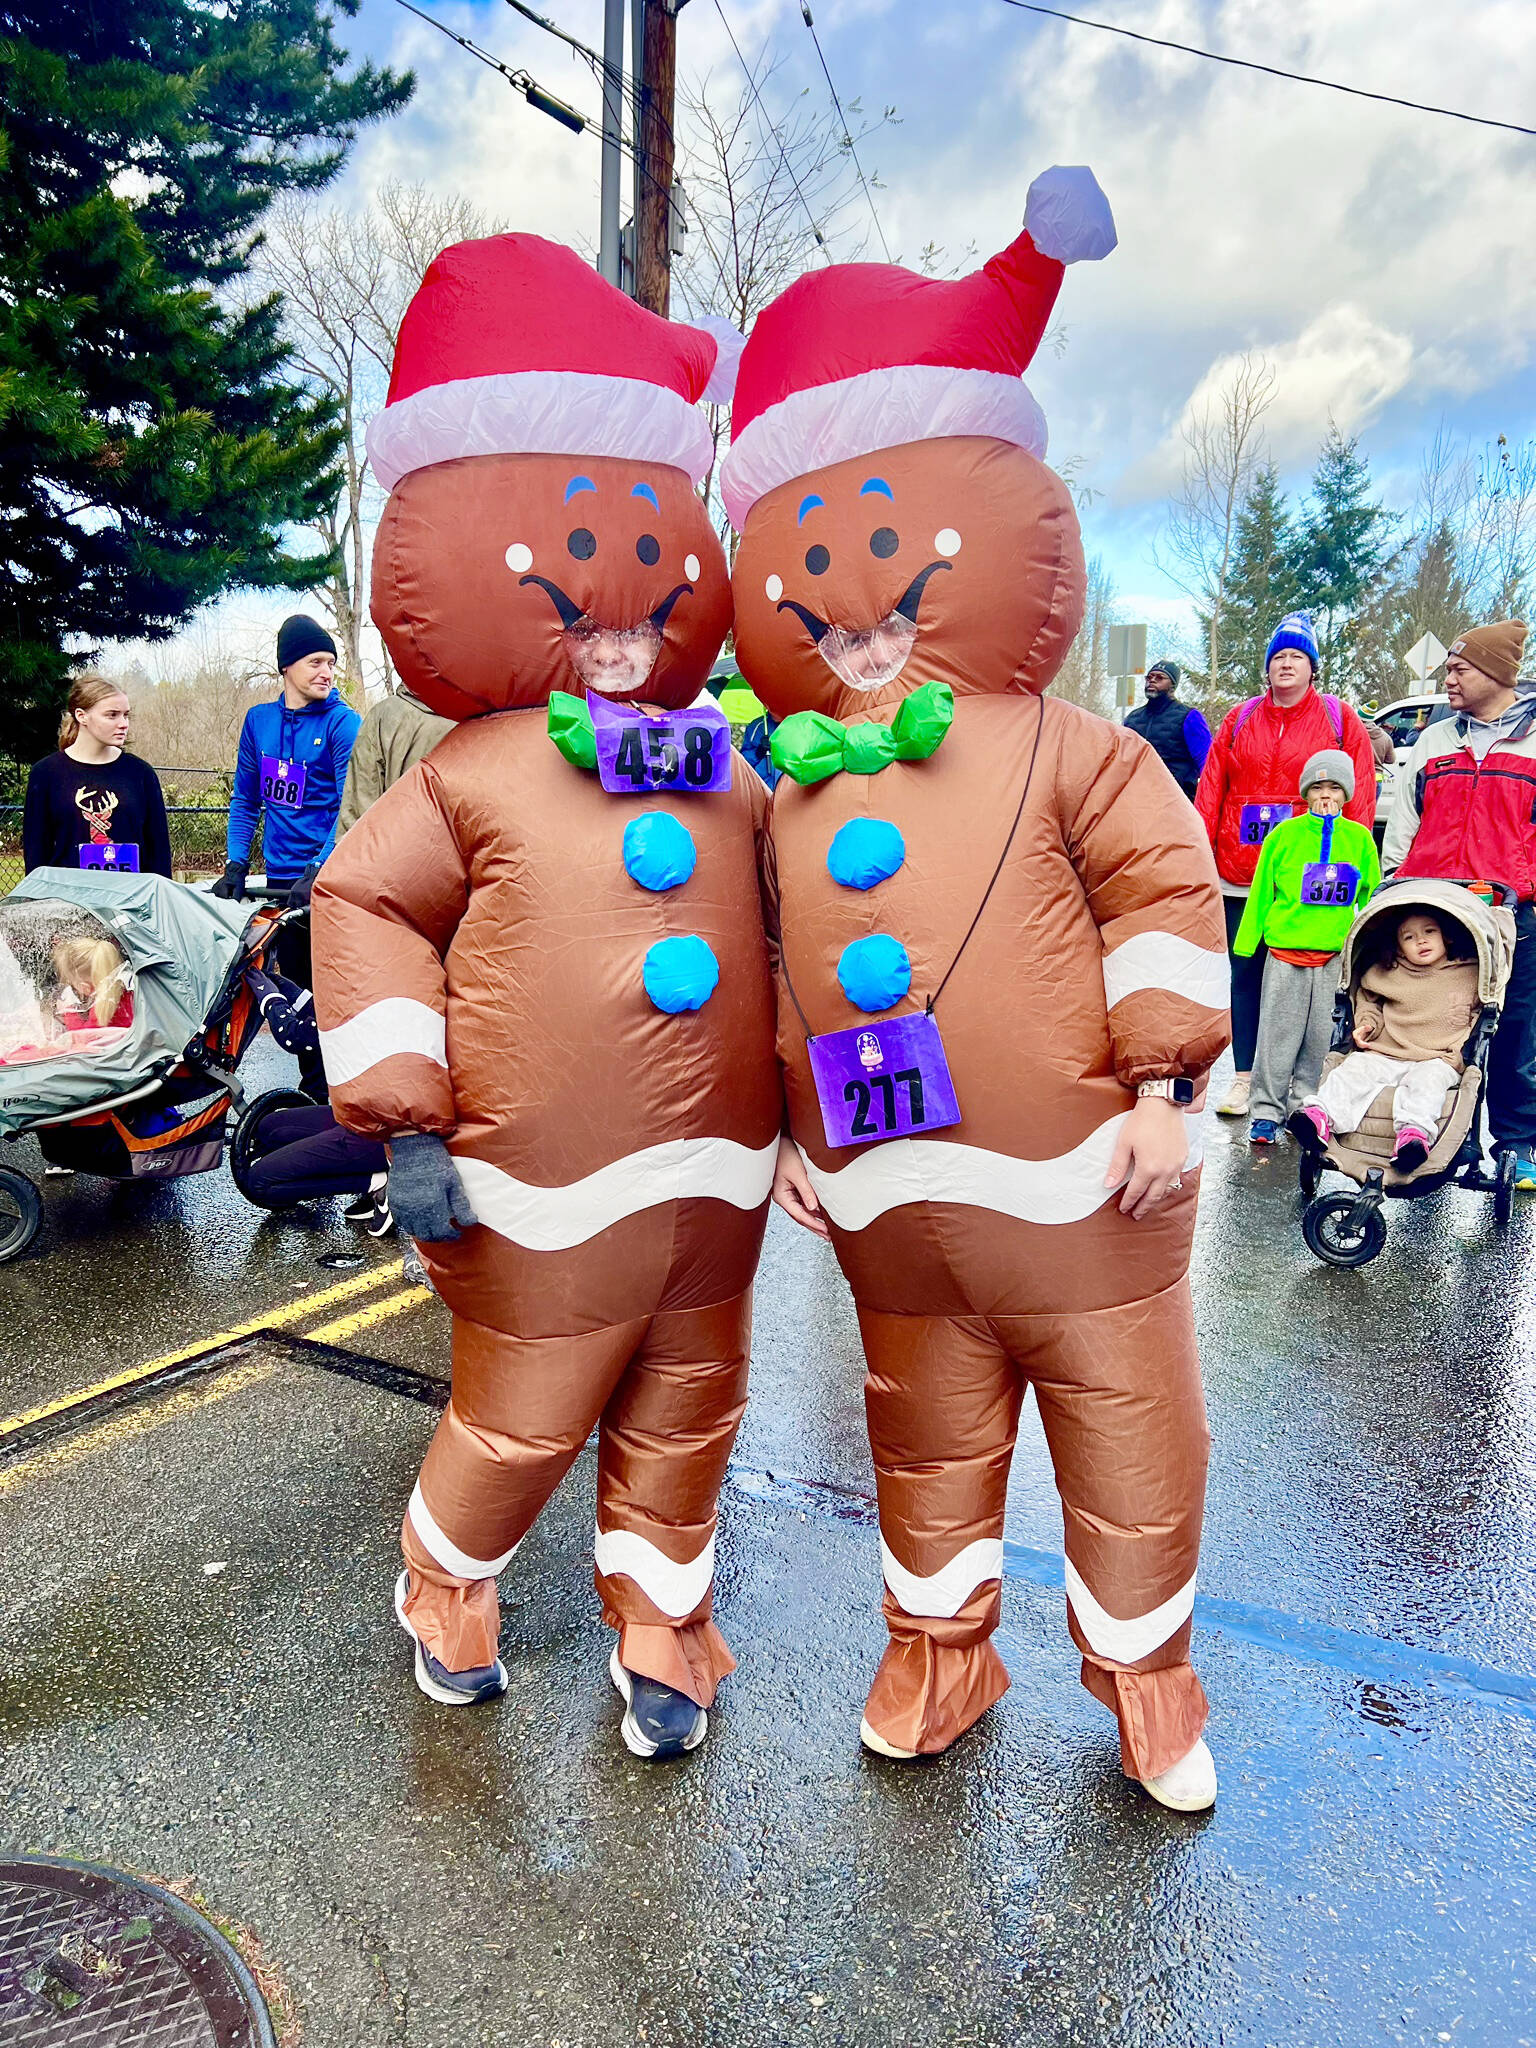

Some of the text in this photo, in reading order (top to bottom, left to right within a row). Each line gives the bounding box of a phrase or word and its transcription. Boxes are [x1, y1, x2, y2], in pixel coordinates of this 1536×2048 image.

[615, 727, 713, 786] 458
[264, 776, 299, 804] 368
[1247, 822, 1281, 842] 37
[1309, 881, 1349, 903] 375
[843, 1067, 925, 1137] 277
